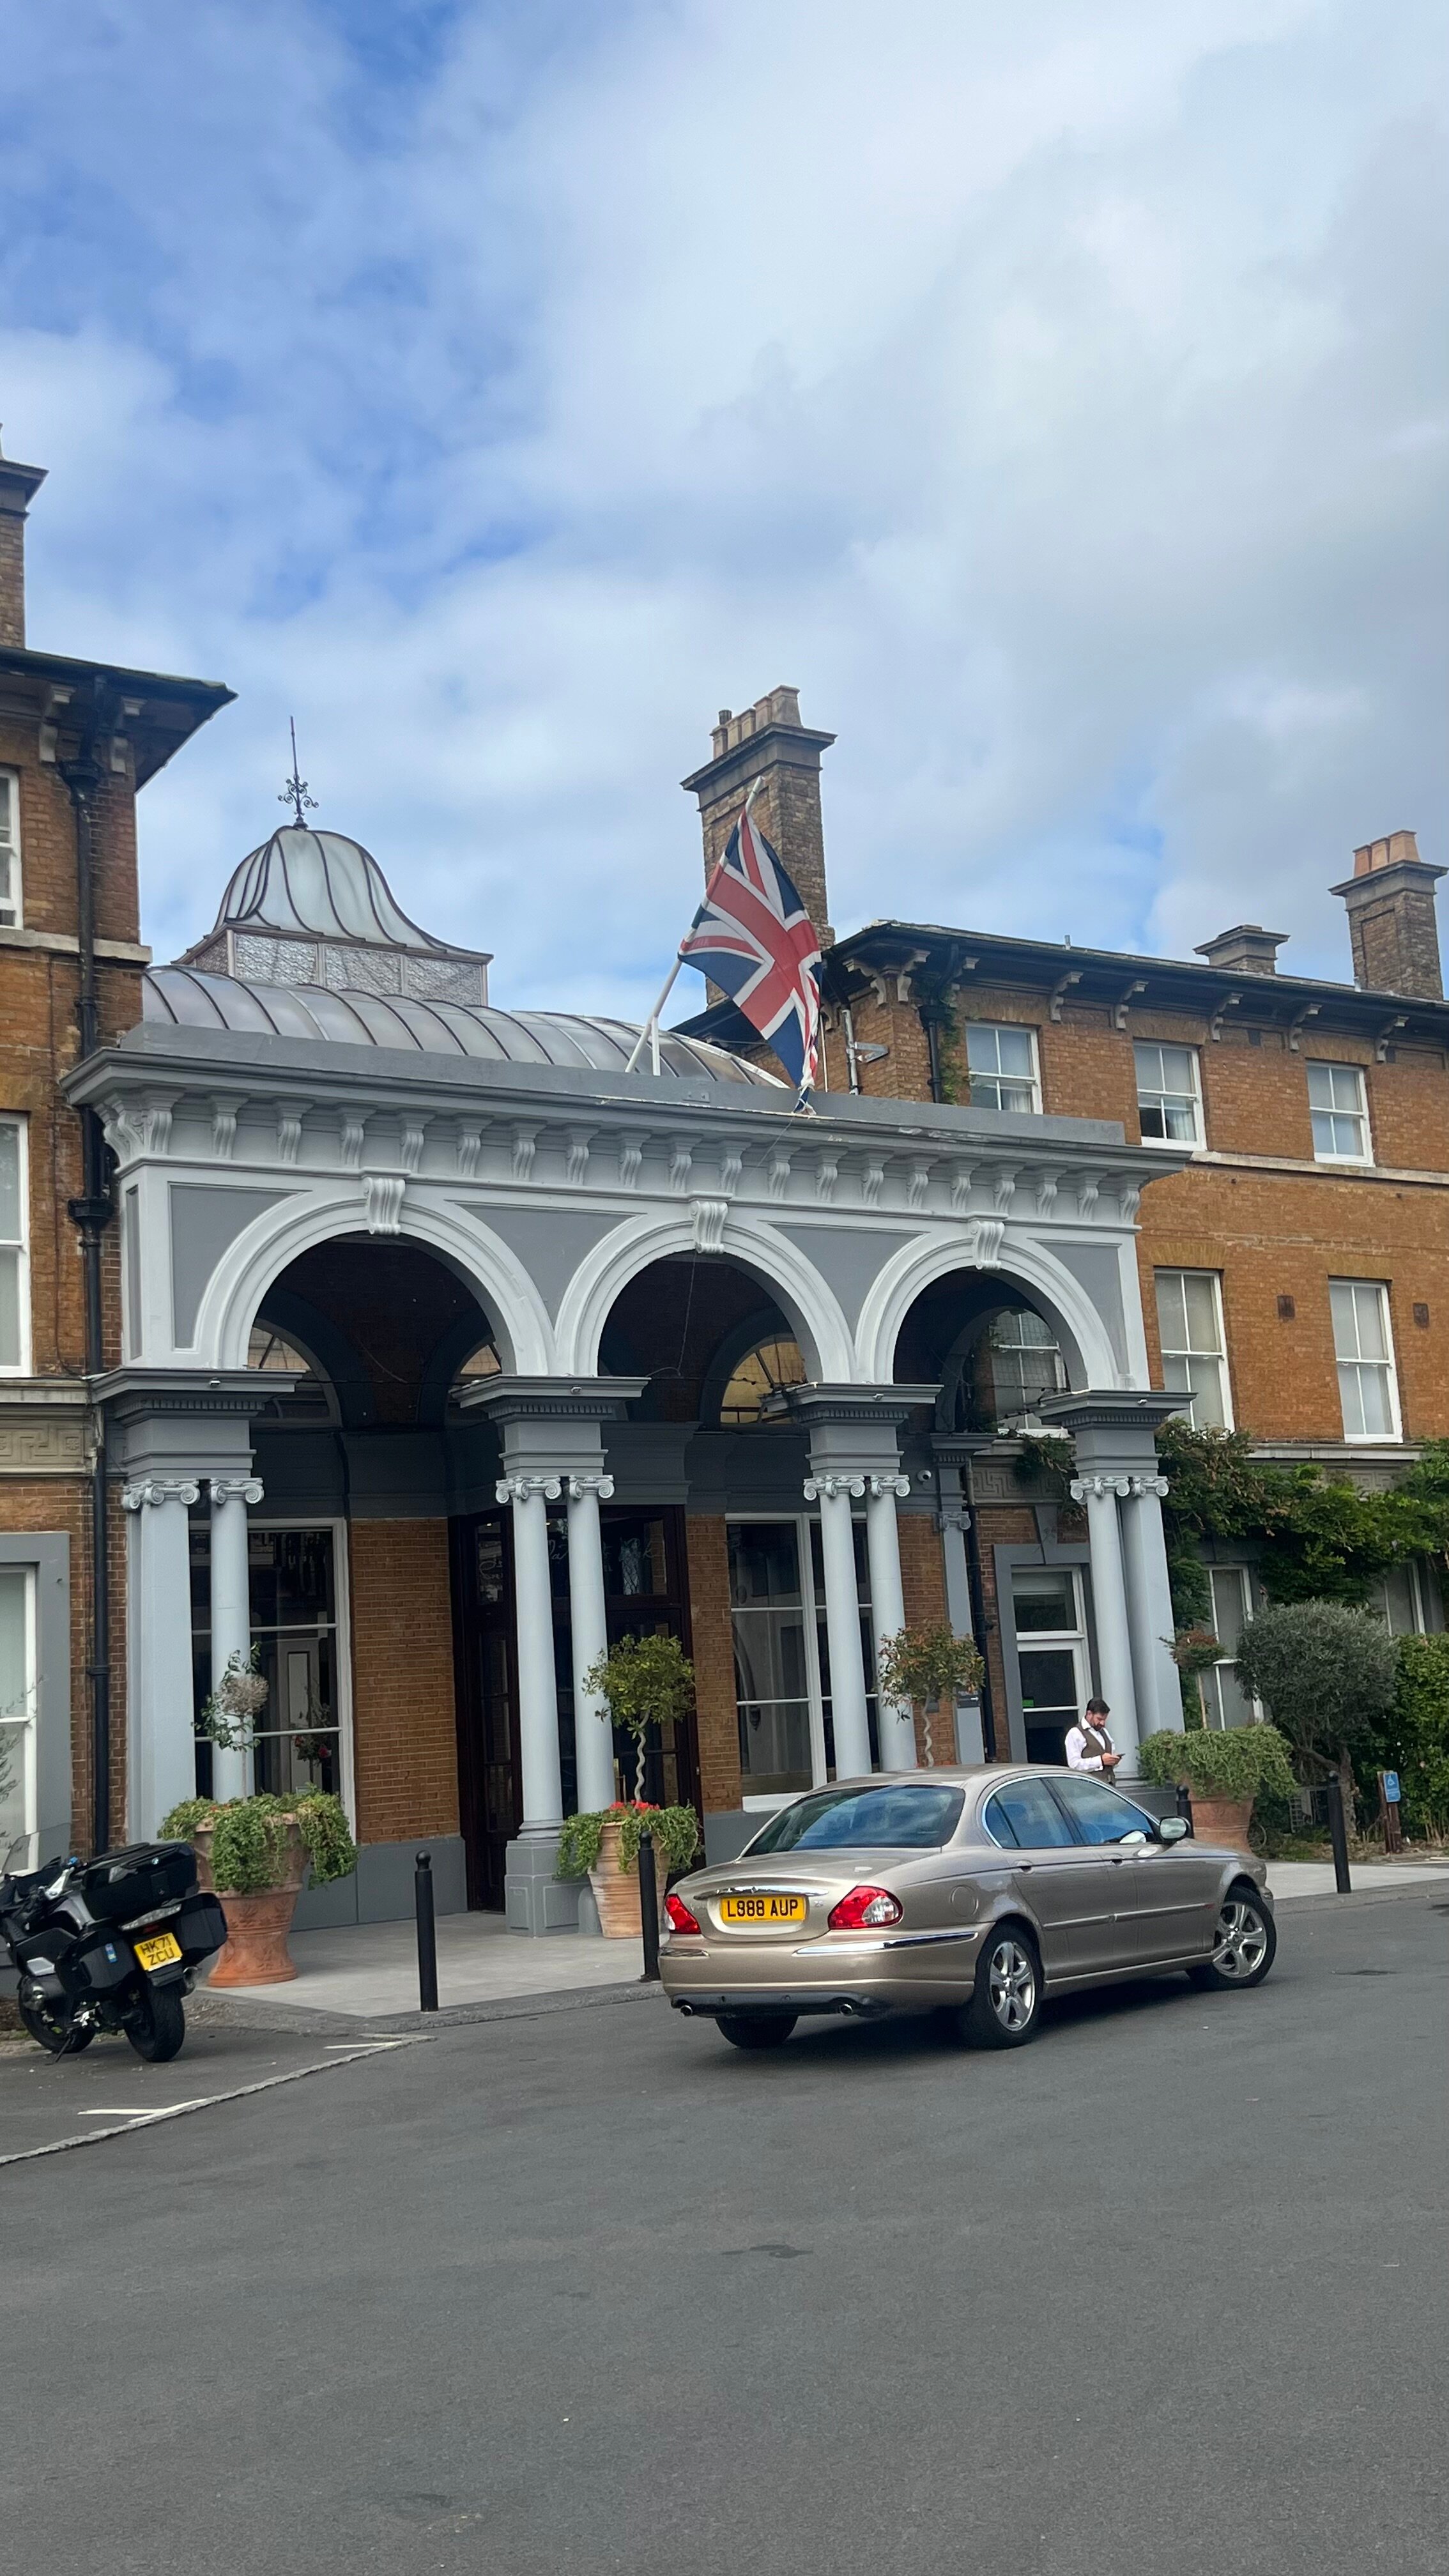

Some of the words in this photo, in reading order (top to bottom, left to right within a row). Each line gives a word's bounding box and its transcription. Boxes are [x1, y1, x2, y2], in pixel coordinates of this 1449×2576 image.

[727, 1899, 765, 1917] L888
[770, 1899, 798, 1916] AUP
[140, 1936, 171, 1955] HK71
[147, 1947, 174, 1965] ZCU
